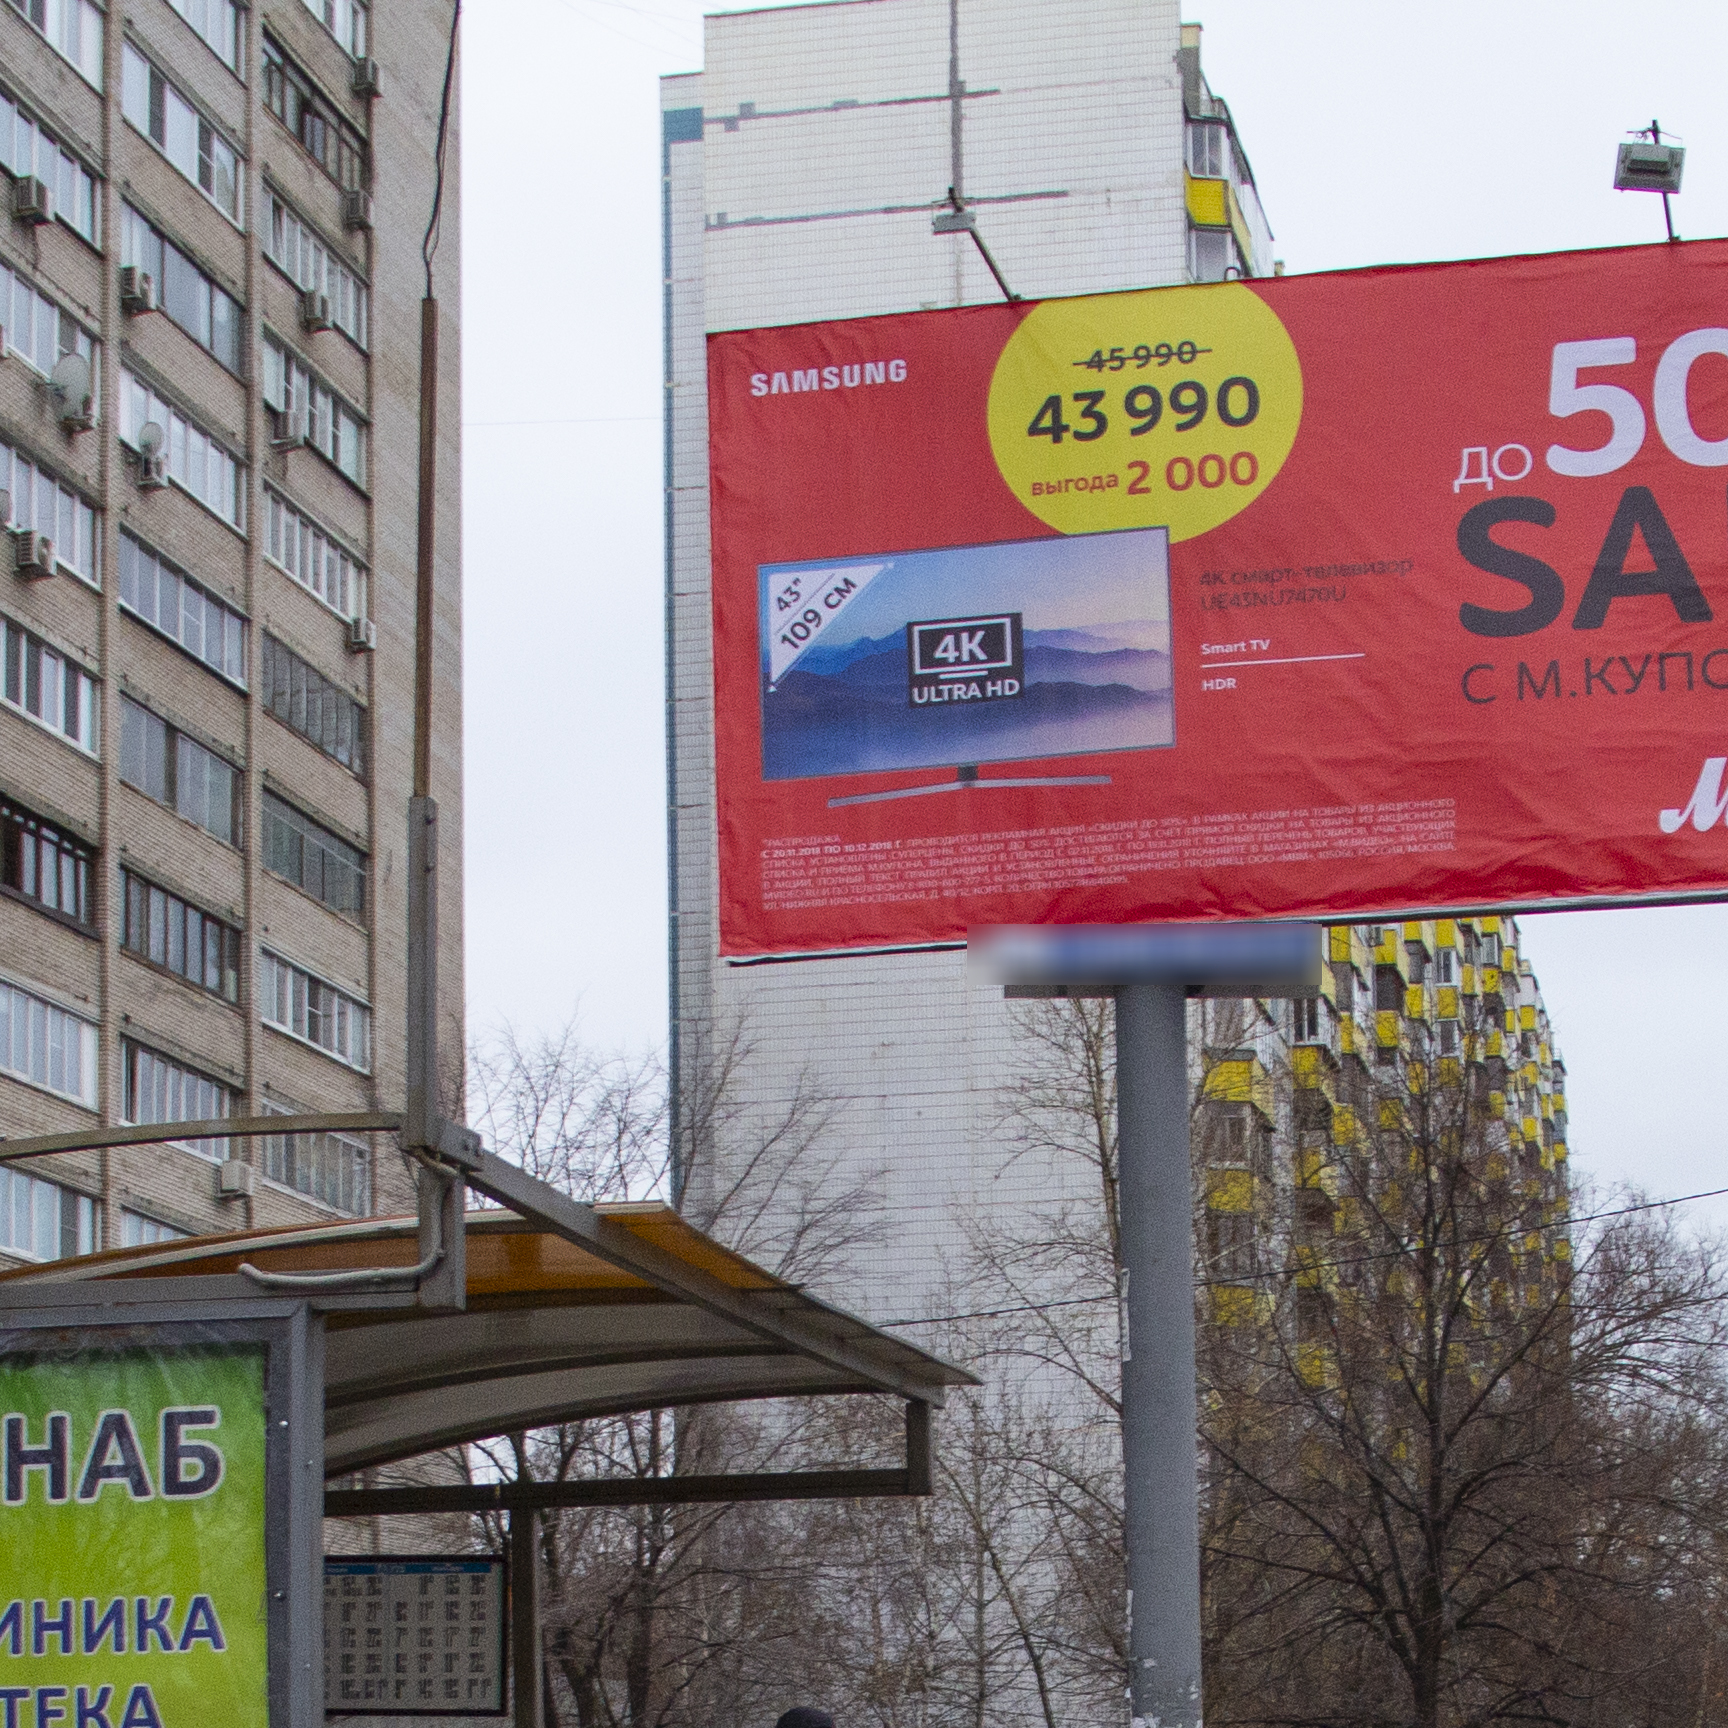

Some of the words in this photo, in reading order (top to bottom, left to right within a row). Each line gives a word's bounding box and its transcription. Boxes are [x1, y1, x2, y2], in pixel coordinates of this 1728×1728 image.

[749, 357, 908, 399] SAMSUNG
[1452, 443, 1533, 493] ДО
[1031, 473, 1119, 497] выгода
[780, 608, 823, 650] 109
[932, 630, 988, 663] 4K
[1200, 641, 1246, 655] Smart
[1250, 639, 1270, 651] TV
[912, 682, 982, 705] ULTRA
[986, 679, 1020, 698] HD
[1201, 678, 1237, 691] HDR
[1460, 663, 1495, 704] С
